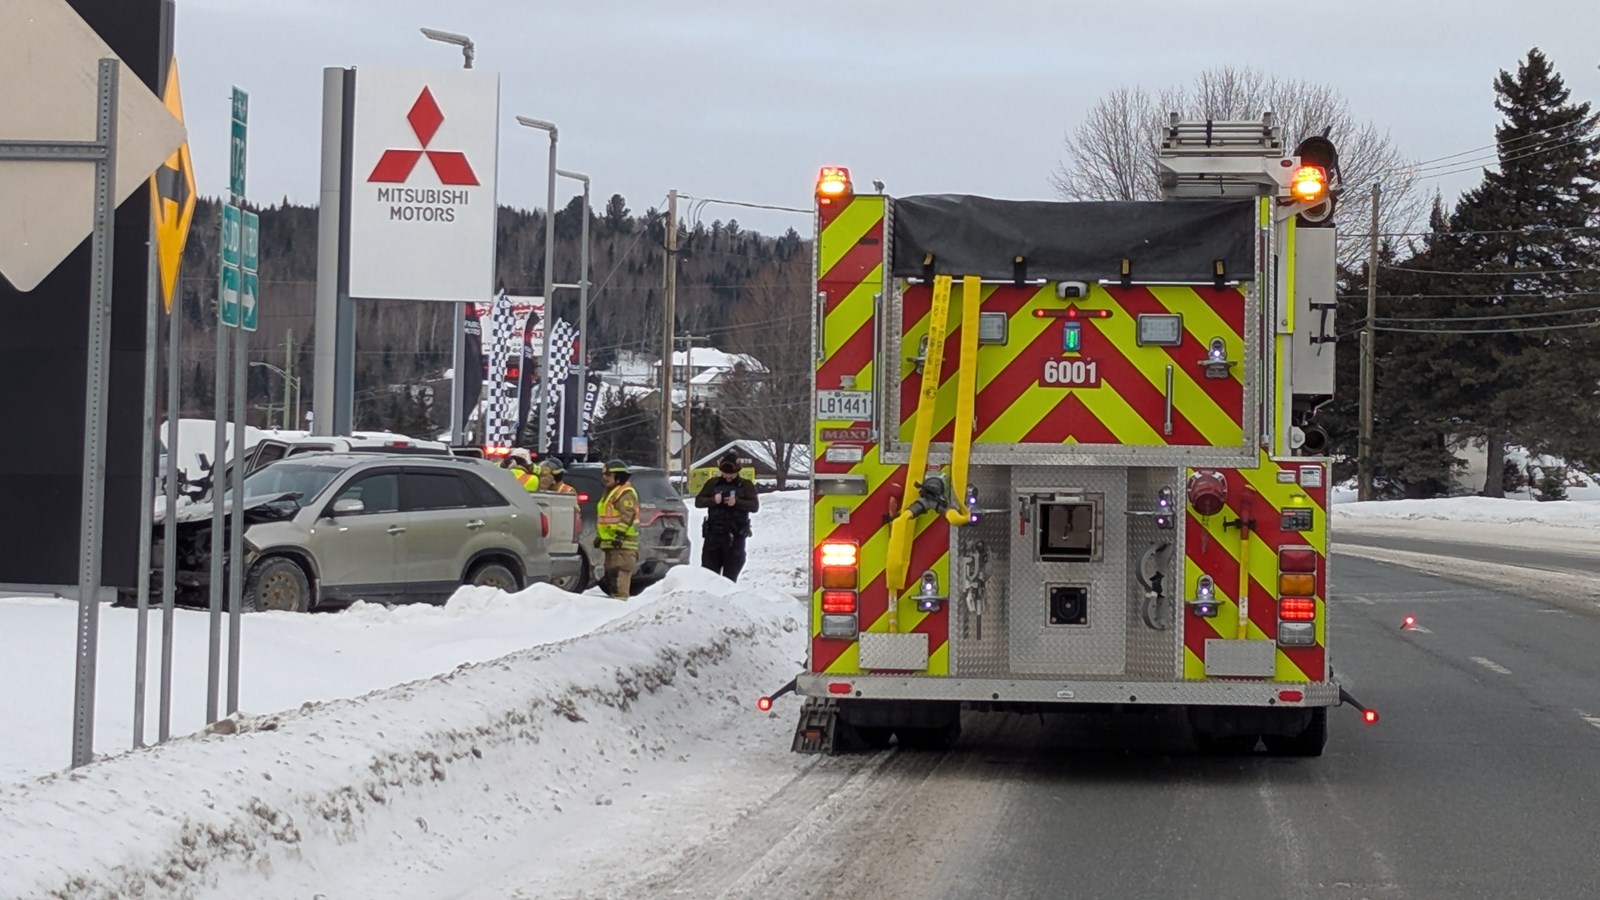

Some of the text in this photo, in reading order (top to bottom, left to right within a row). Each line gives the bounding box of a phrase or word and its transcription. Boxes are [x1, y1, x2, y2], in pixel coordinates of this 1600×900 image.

[377, 187, 469, 205] MITSUBISHI
[390, 206, 455, 222] MOTORS
[223, 217, 240, 252] SUD
[1044, 360, 1097, 384] 6001
[819, 397, 873, 414] L81441
